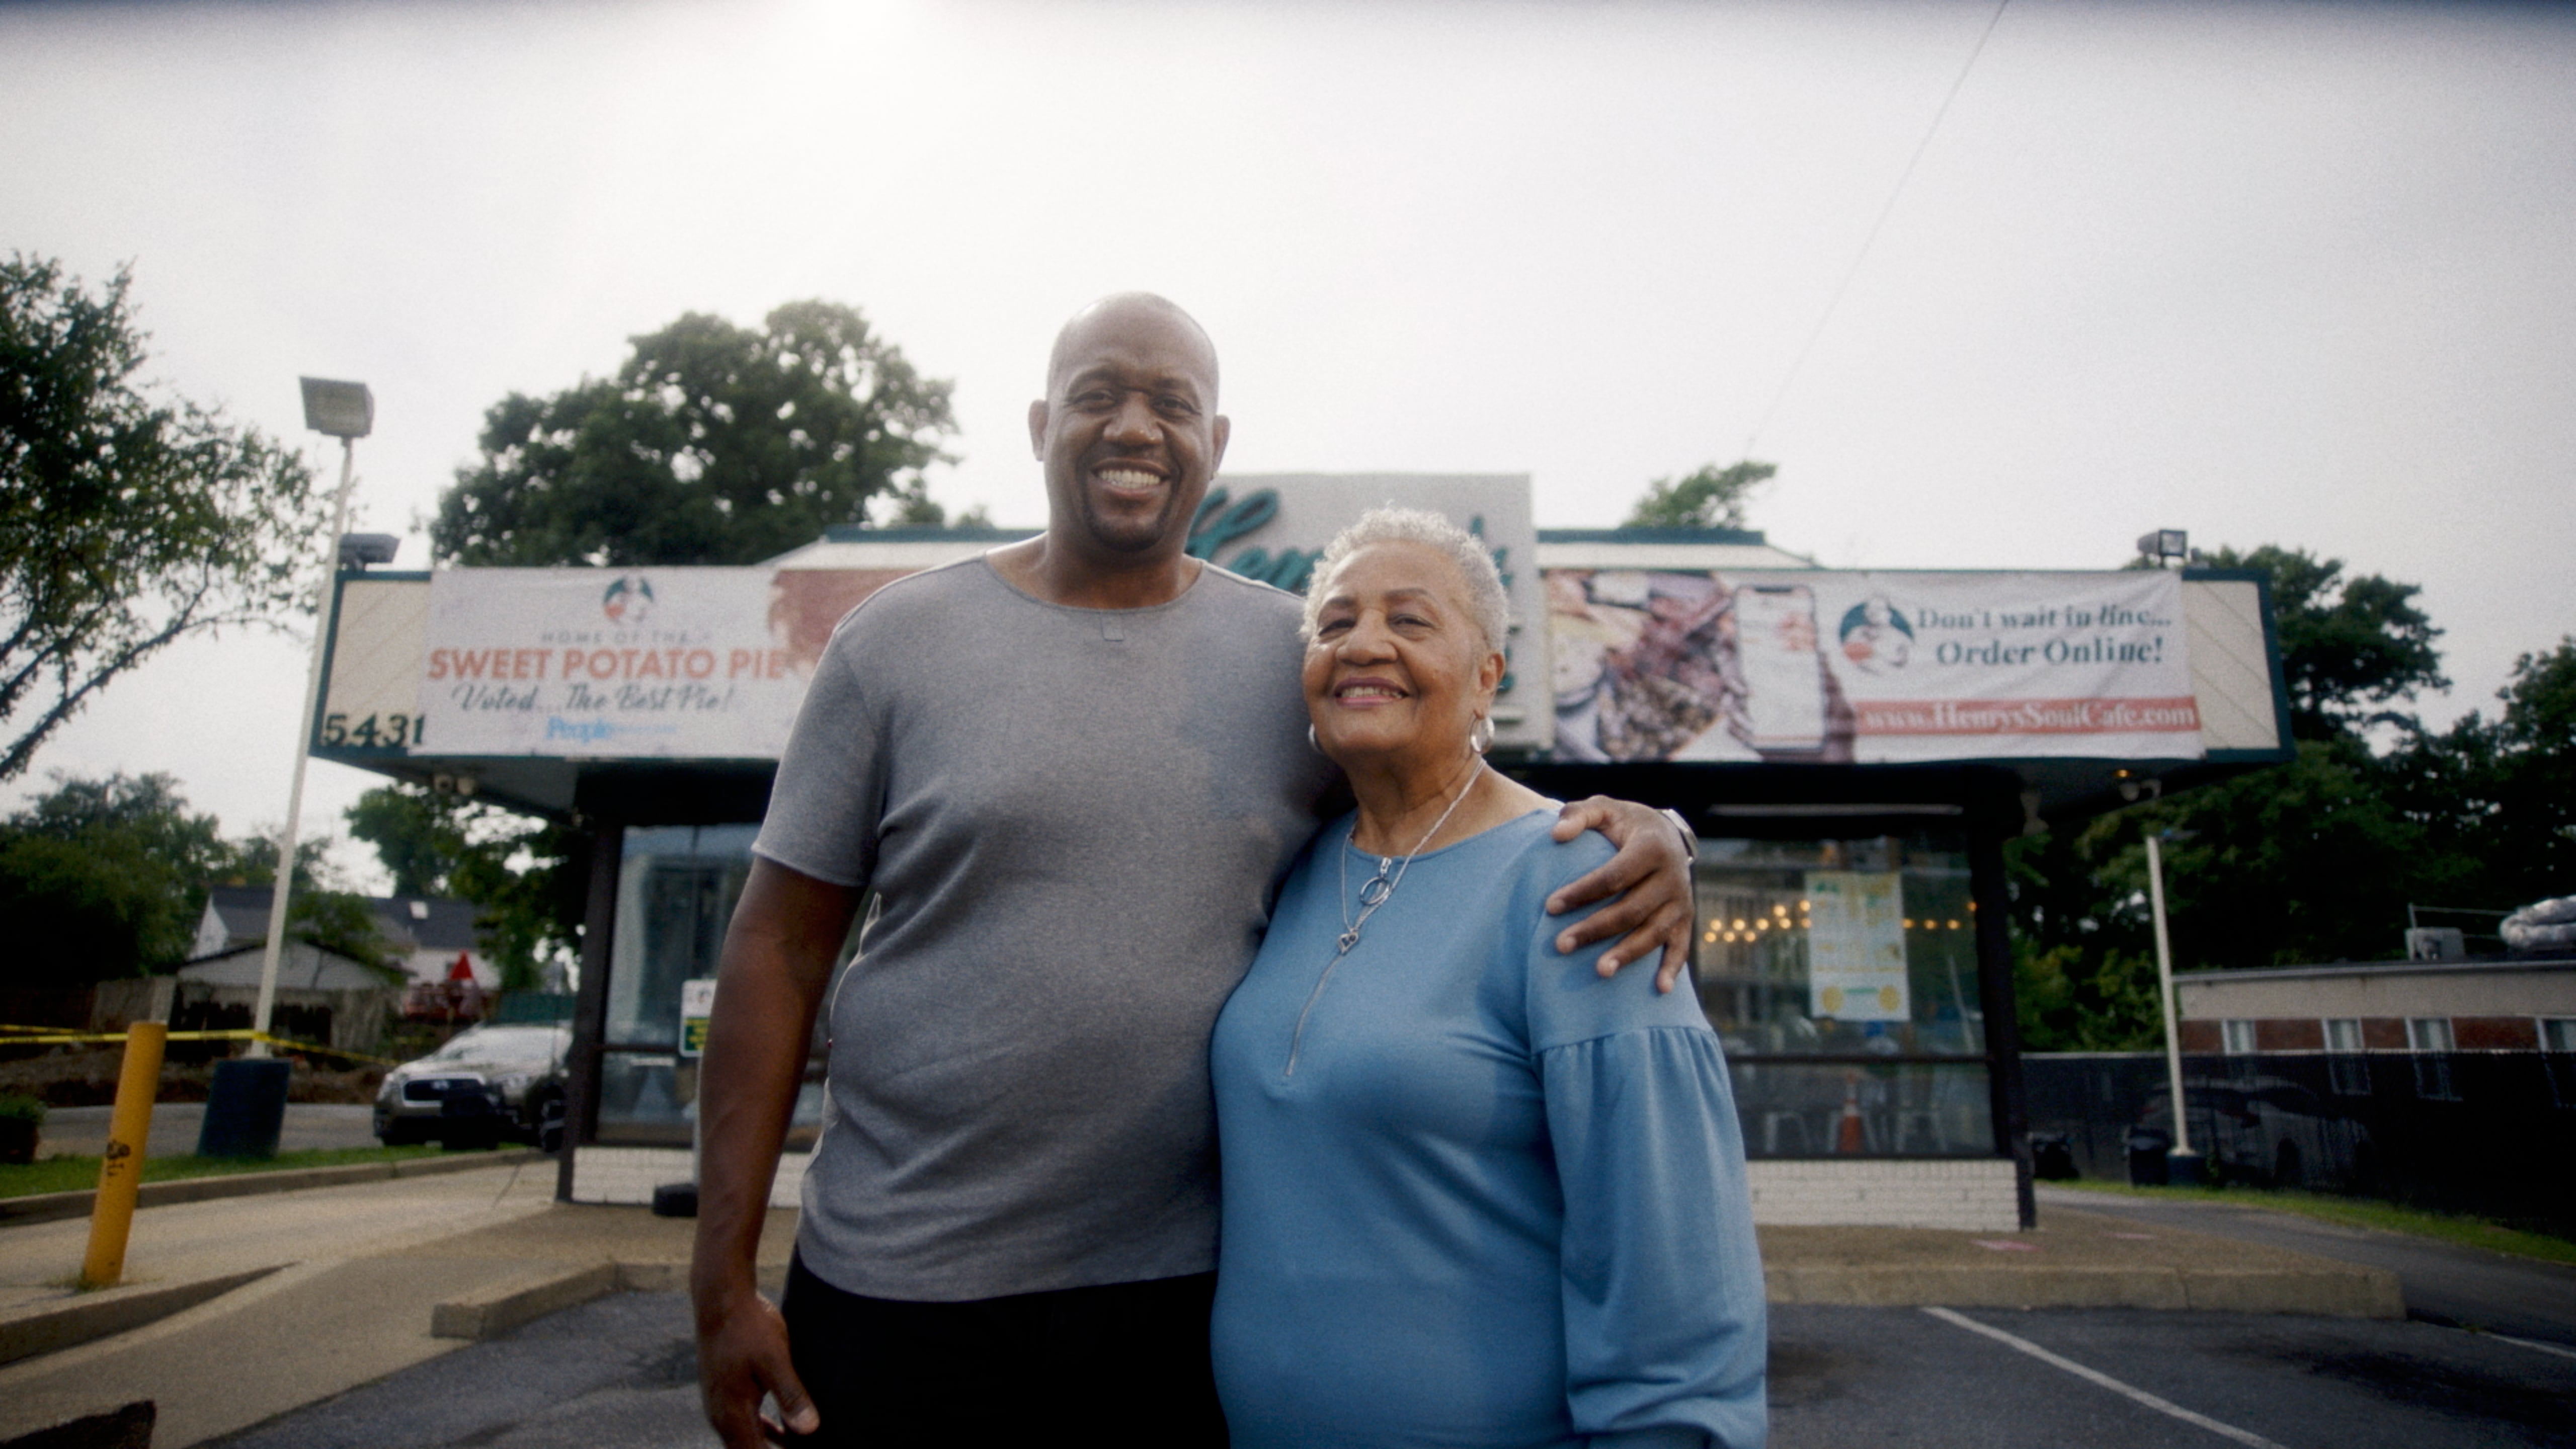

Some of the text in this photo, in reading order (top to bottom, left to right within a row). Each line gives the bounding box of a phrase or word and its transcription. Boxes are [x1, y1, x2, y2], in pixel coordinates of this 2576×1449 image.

[1918, 608, 1991, 628] Don't
[2000, 606, 2056, 627] wait
[2066, 605, 2091, 627] in
[428, 647, 786, 680] SWEET POTATO PIE
[1937, 635, 2163, 665] Order Online!
[566, 682, 608, 710] The
[615, 683, 673, 711] Best
[678, 683, 735, 712] Pie!
[324, 712, 425, 749] 5431
